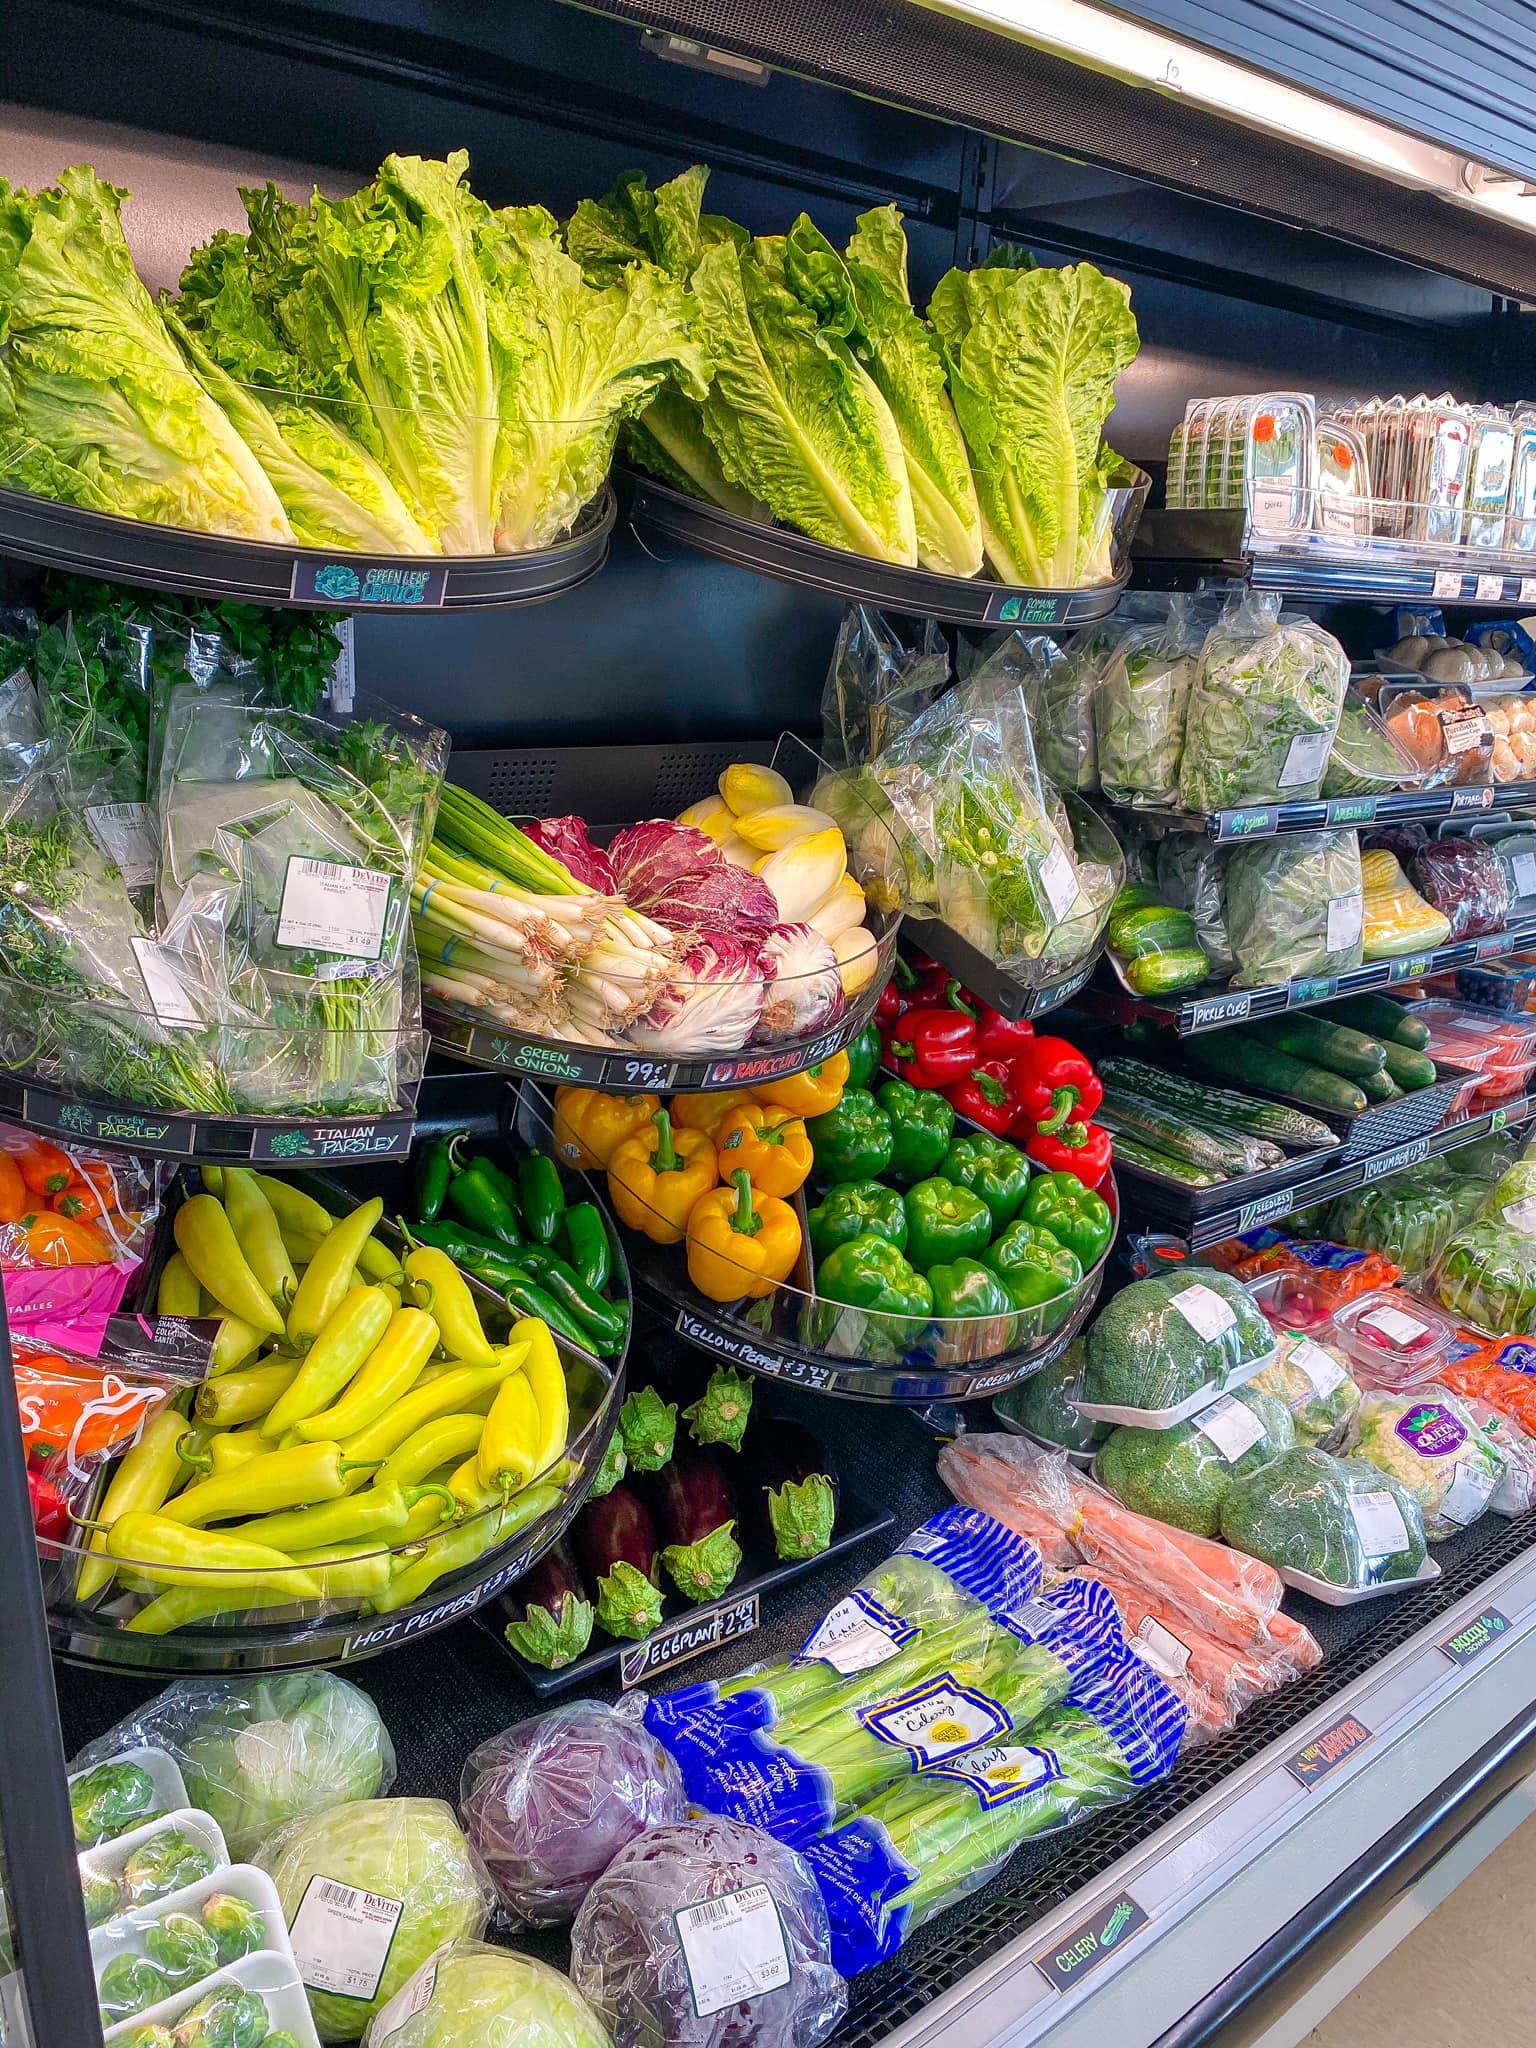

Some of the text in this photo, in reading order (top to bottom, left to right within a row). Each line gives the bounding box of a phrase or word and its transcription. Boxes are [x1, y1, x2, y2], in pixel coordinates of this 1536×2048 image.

[366, 568, 430, 586] GREEN LEAF
[361, 583, 426, 604] LETTUCE
[1025, 597, 1059, 610] ROMAINE
[1021, 609, 1057, 623] LETTUCE
[1196, 1005, 1225, 1025] PICKLE
[520, 1045, 570, 1065] GREEN
[514, 1055, 583, 1078] ONIONS
[733, 1051, 802, 1081] RADICCHIO
[96, 1121, 171, 1140] PARSLEY
[313, 1126, 375, 1141] ITALIAN
[320, 1135, 399, 1156] PARSLEY
[1256, 1193, 1291, 1214] SEEDLESS
[1251, 1204, 1291, 1227] CUCUMBER
[684, 1314, 740, 1353] YELLOW
[975, 1370, 1016, 1391] GREEN
[1417, 1422, 1457, 1447] QUEEN
[352, 1589, 477, 1650] HOT PEPPER
[651, 1621, 719, 1665] EGGPLANT
[893, 1699, 945, 1726] PREMIUM
[905, 1704, 956, 1733] Celery
[1055, 1931, 1099, 1973] CELERY
